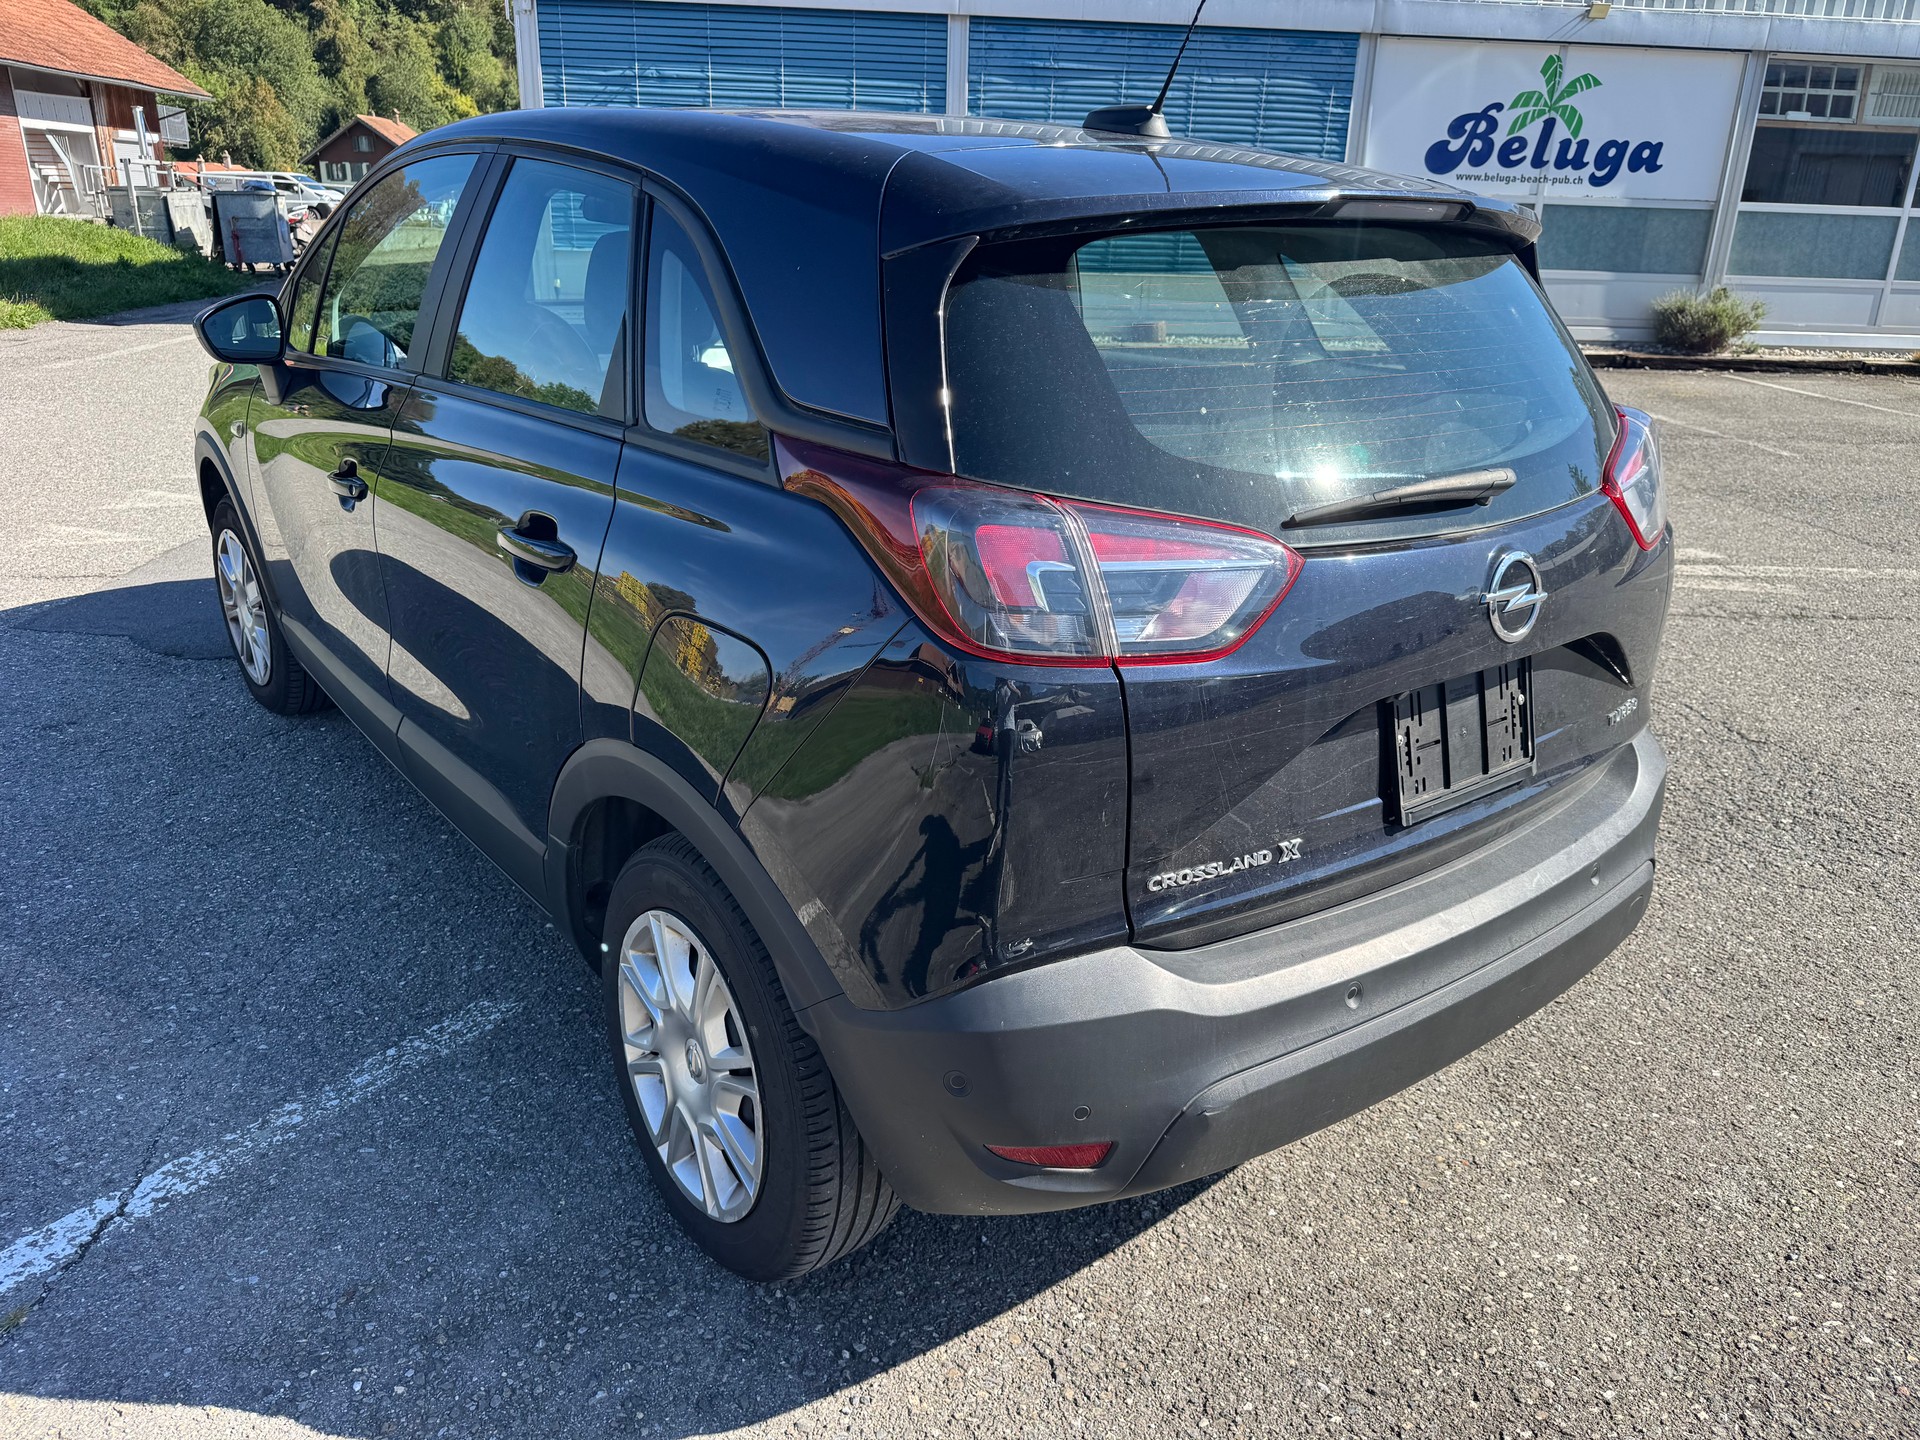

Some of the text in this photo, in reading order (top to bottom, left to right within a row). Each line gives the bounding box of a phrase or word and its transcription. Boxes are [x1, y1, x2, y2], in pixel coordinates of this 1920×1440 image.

[1424, 102, 1664, 187] Beluga
[1456, 172, 1583, 186] www.beluga-beach-pub.ch
[1147, 838, 1303, 892] CROSSLAND X
